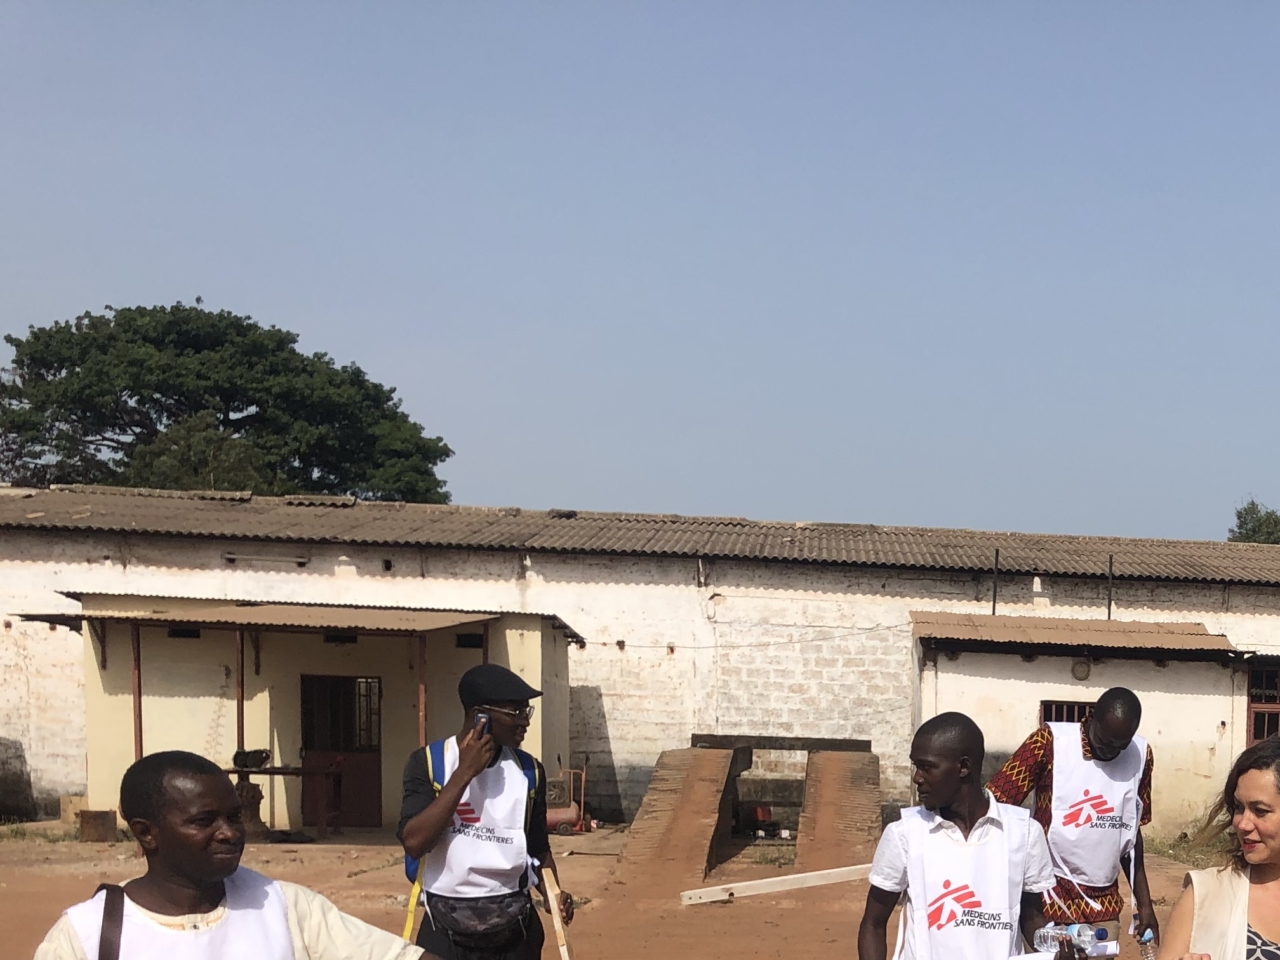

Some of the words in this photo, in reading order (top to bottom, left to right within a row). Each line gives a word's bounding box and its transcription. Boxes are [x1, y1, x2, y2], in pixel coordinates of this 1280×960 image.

[459, 822, 496, 835] MEDECINS
[451, 827, 471, 837] SANS
[472, 832, 514, 844] FRONTIERES
[961, 909, 1002, 921] MEDECINS
[954, 918, 976, 928] SANS
[976, 919, 1014, 932] FRONTIER
